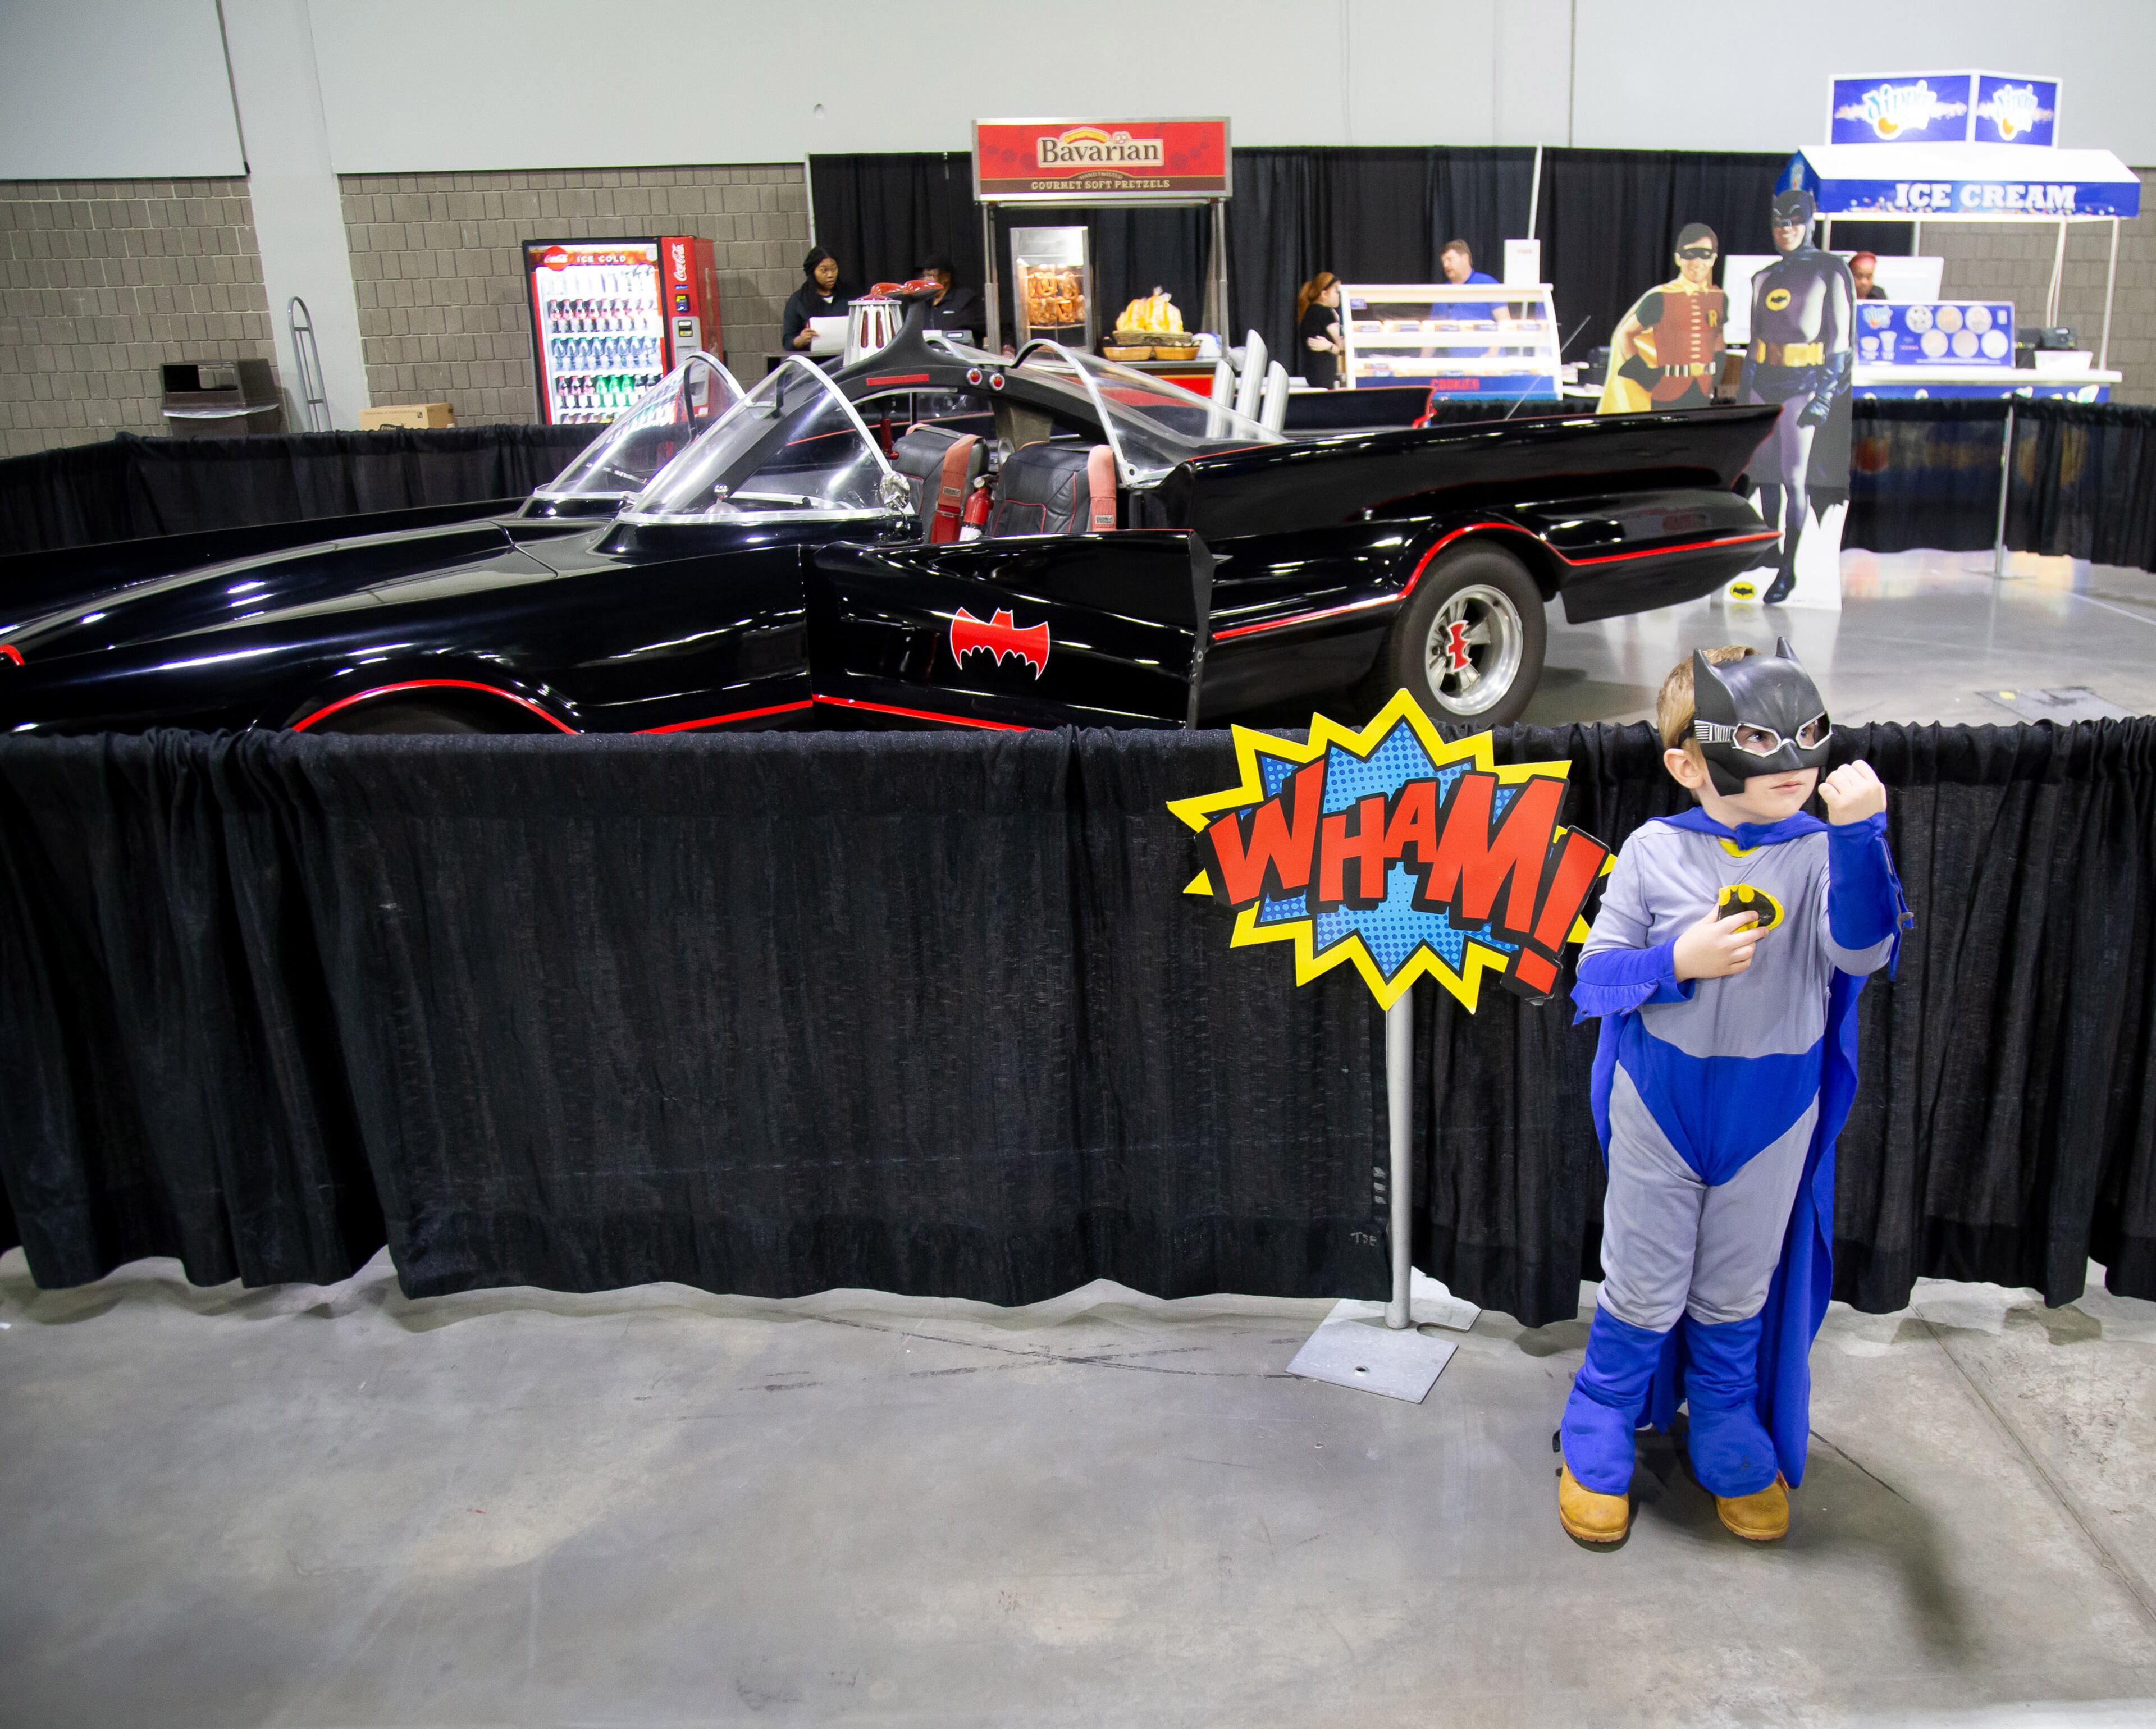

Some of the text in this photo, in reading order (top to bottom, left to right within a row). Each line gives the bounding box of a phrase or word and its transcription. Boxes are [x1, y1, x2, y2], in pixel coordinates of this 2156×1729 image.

[1042, 139, 1159, 163] Bavarian
[1031, 180, 1170, 190] GOURMET SOFT PRETZELS
[1895, 182, 2077, 209] ICE CREAM
[598, 255, 627, 263] COLD
[1208, 759, 1607, 995] WHAM!
